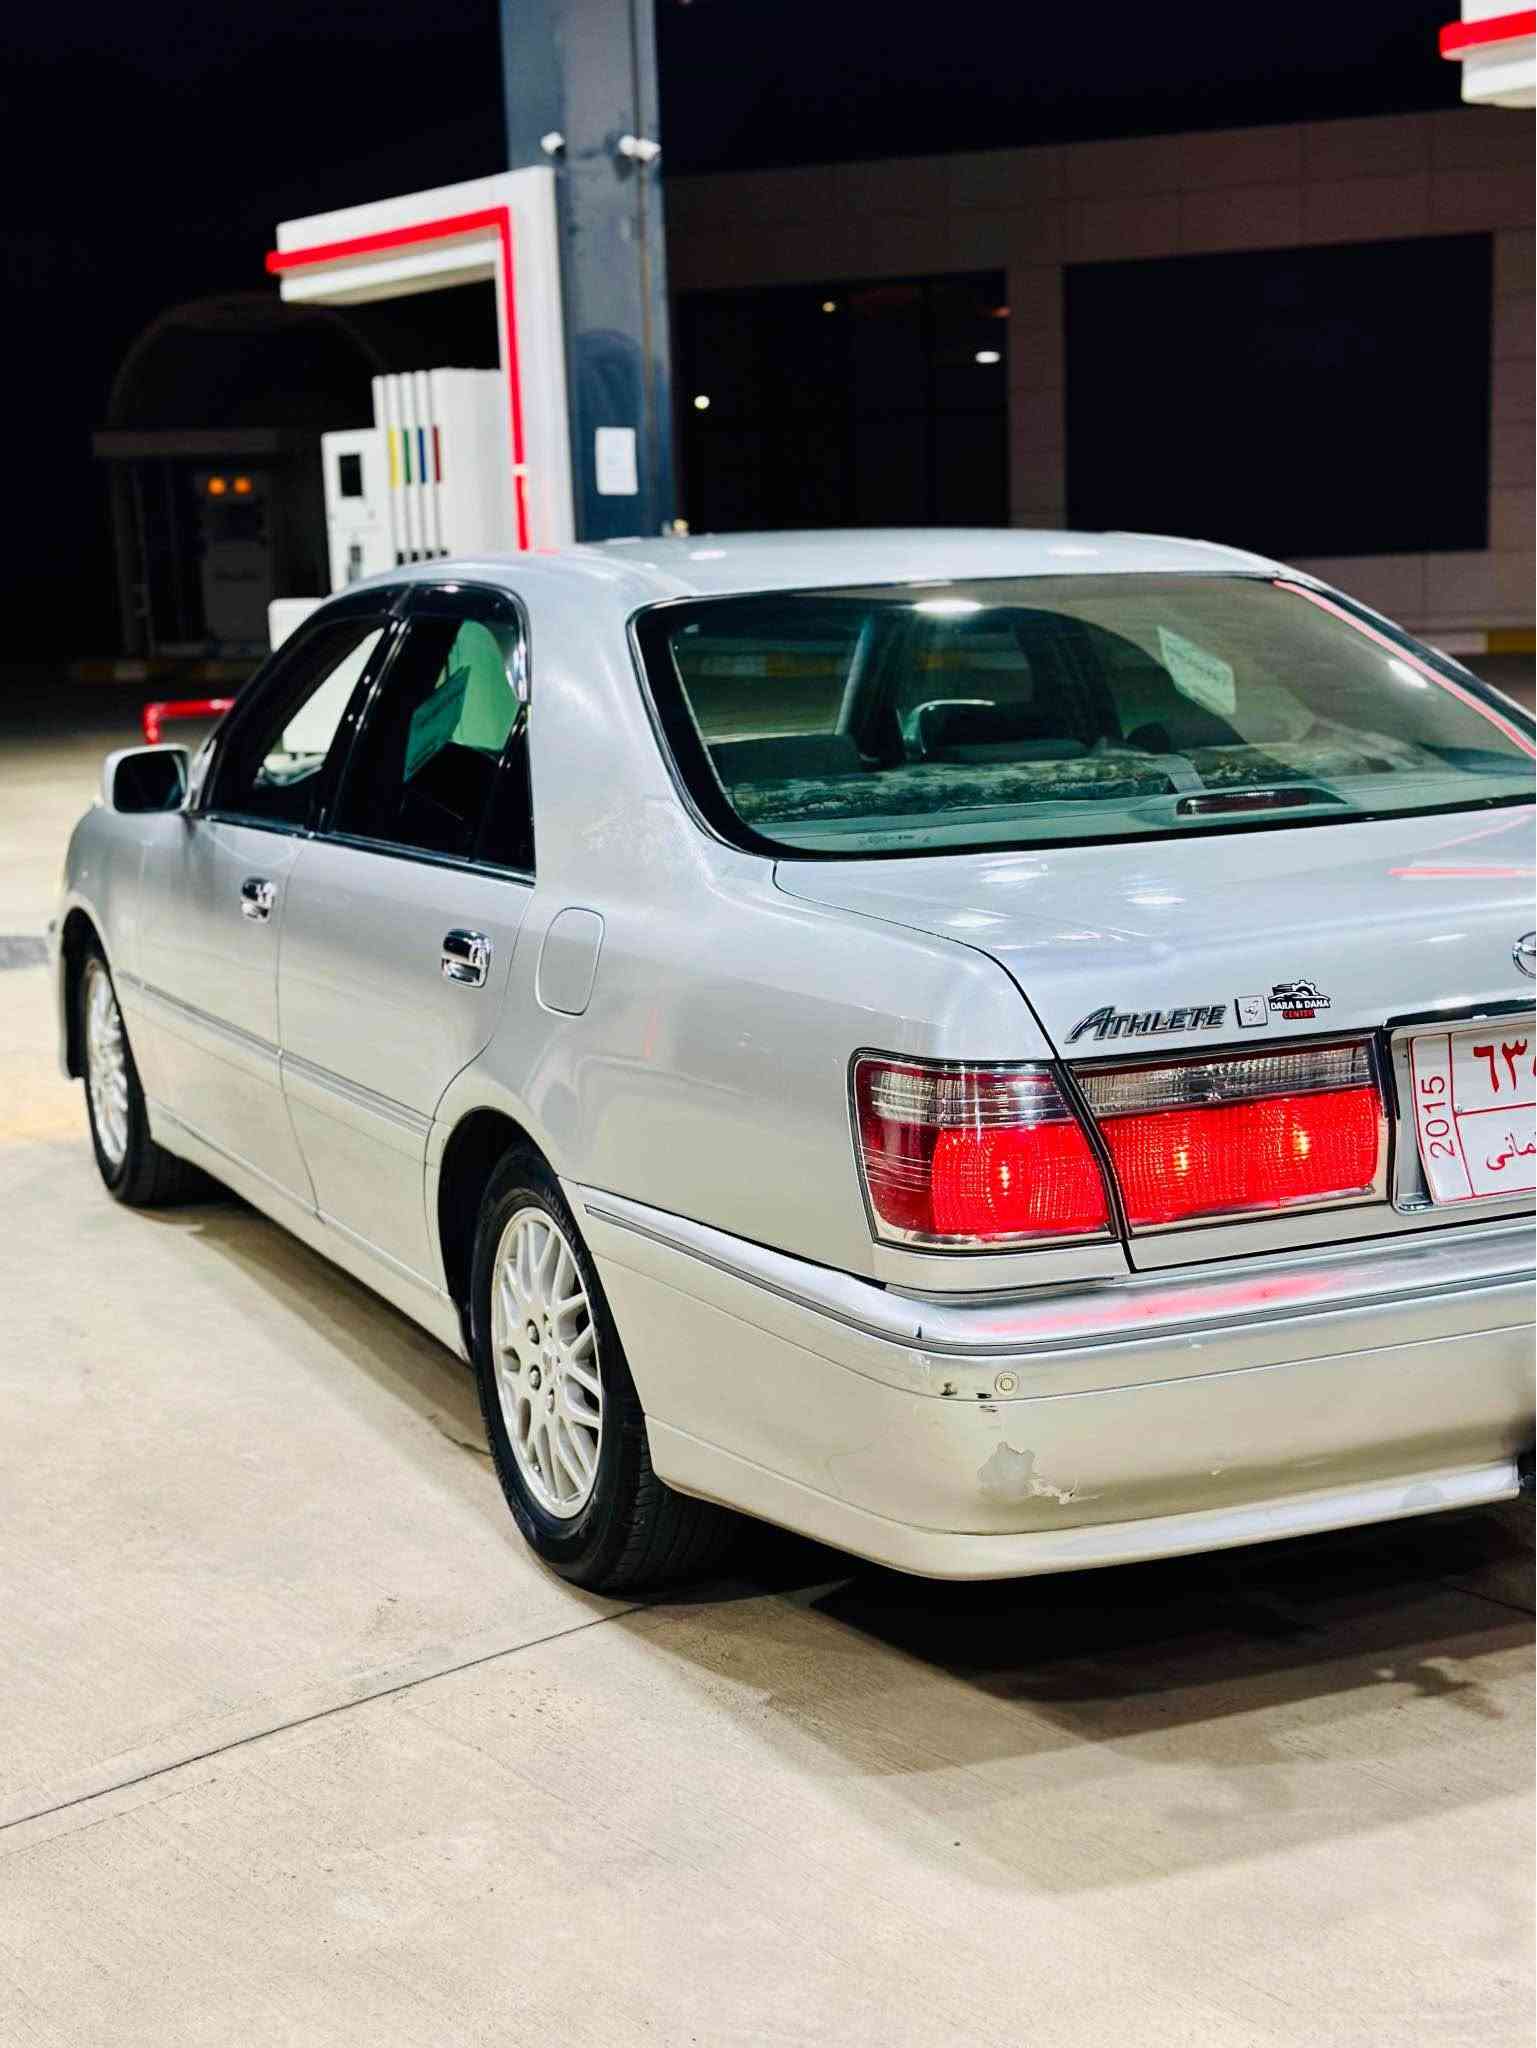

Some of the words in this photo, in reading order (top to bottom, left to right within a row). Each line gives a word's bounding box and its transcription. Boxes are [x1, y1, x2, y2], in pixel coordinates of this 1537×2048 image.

[1064, 1005, 1227, 1044] ATHLETE
[1271, 1001, 1294, 1010] DARA
[1296, 1001, 1303, 1009] &
[1473, 1039, 1536, 1093] ٦٣
[1421, 1076, 1456, 1159] 2015
